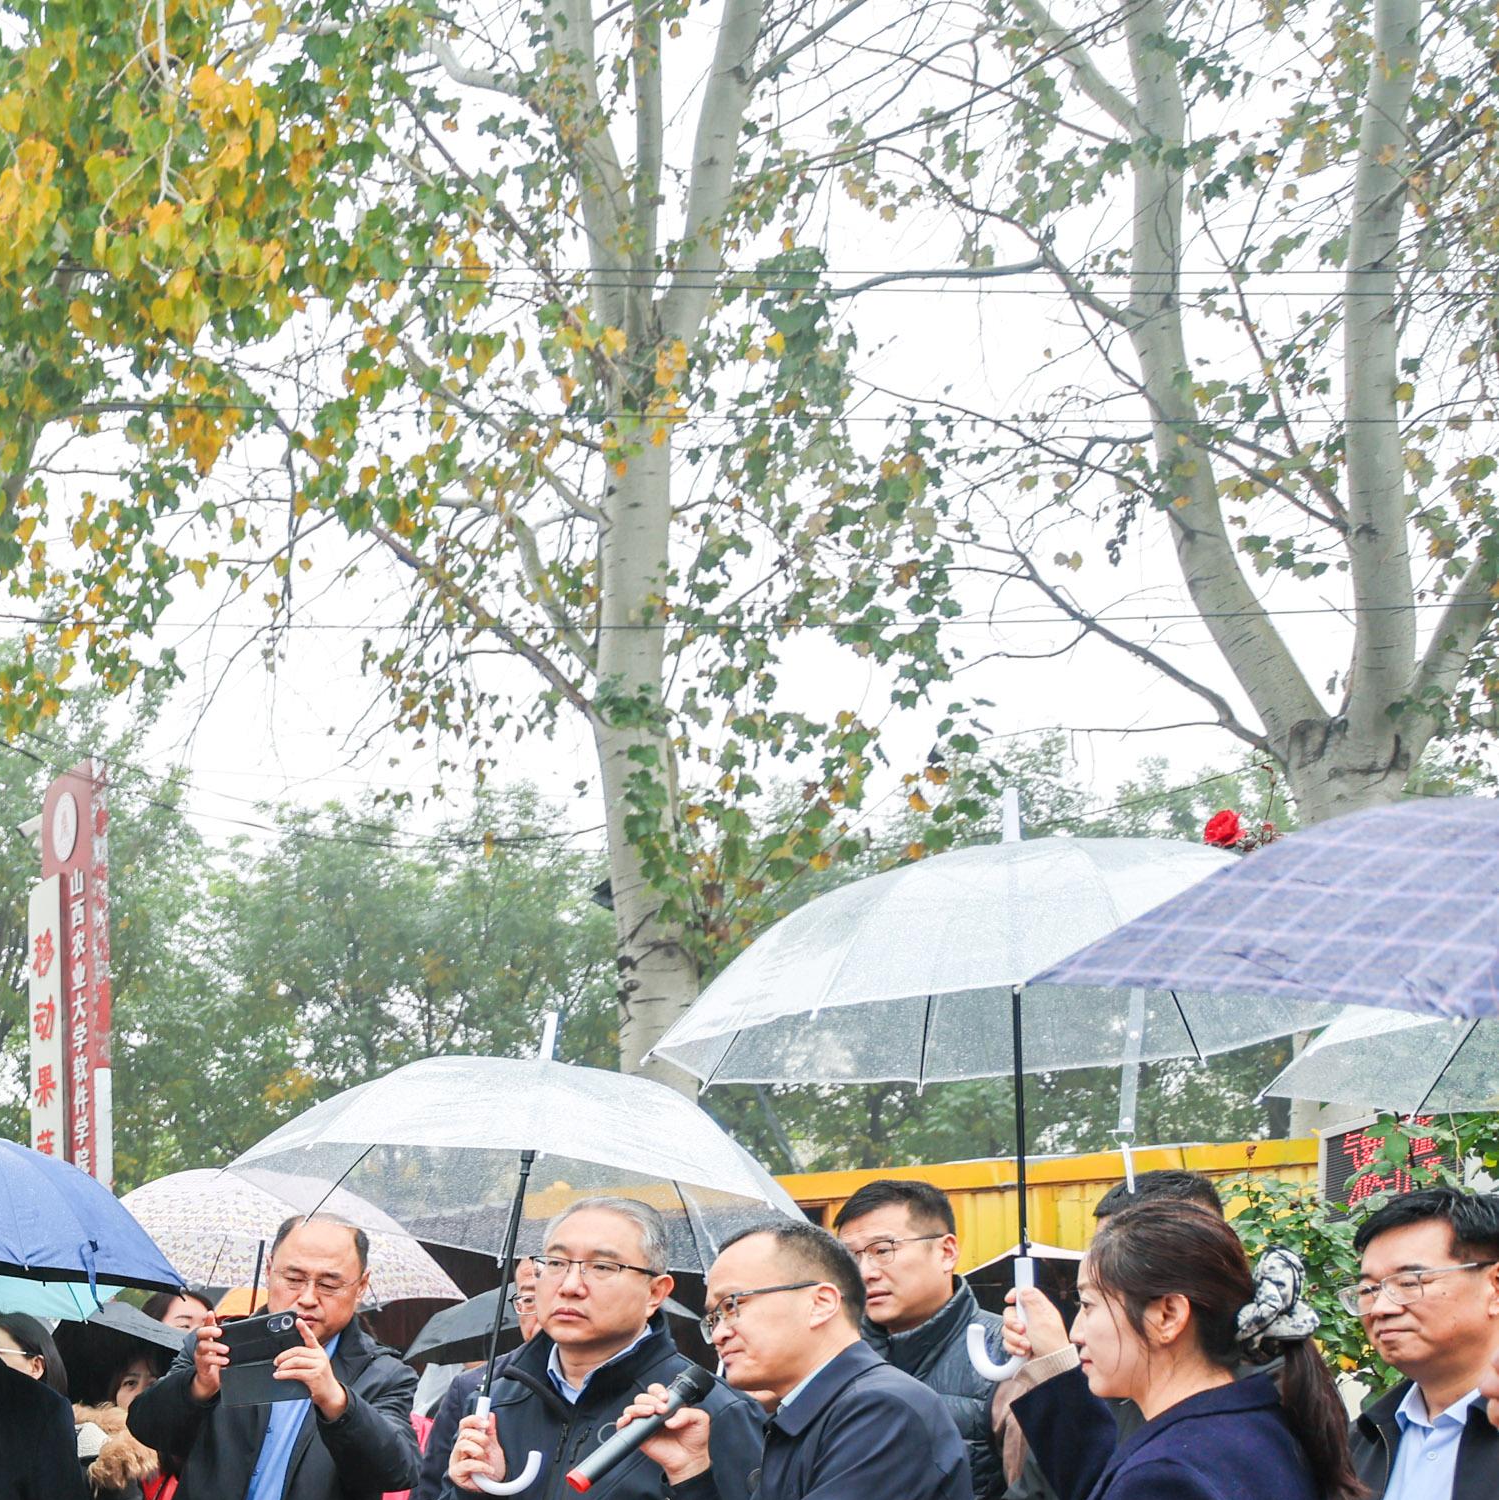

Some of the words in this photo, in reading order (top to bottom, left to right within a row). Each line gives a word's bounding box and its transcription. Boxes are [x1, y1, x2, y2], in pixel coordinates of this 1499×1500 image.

[68, 868, 91, 1174] 山西农业大学软件学院
